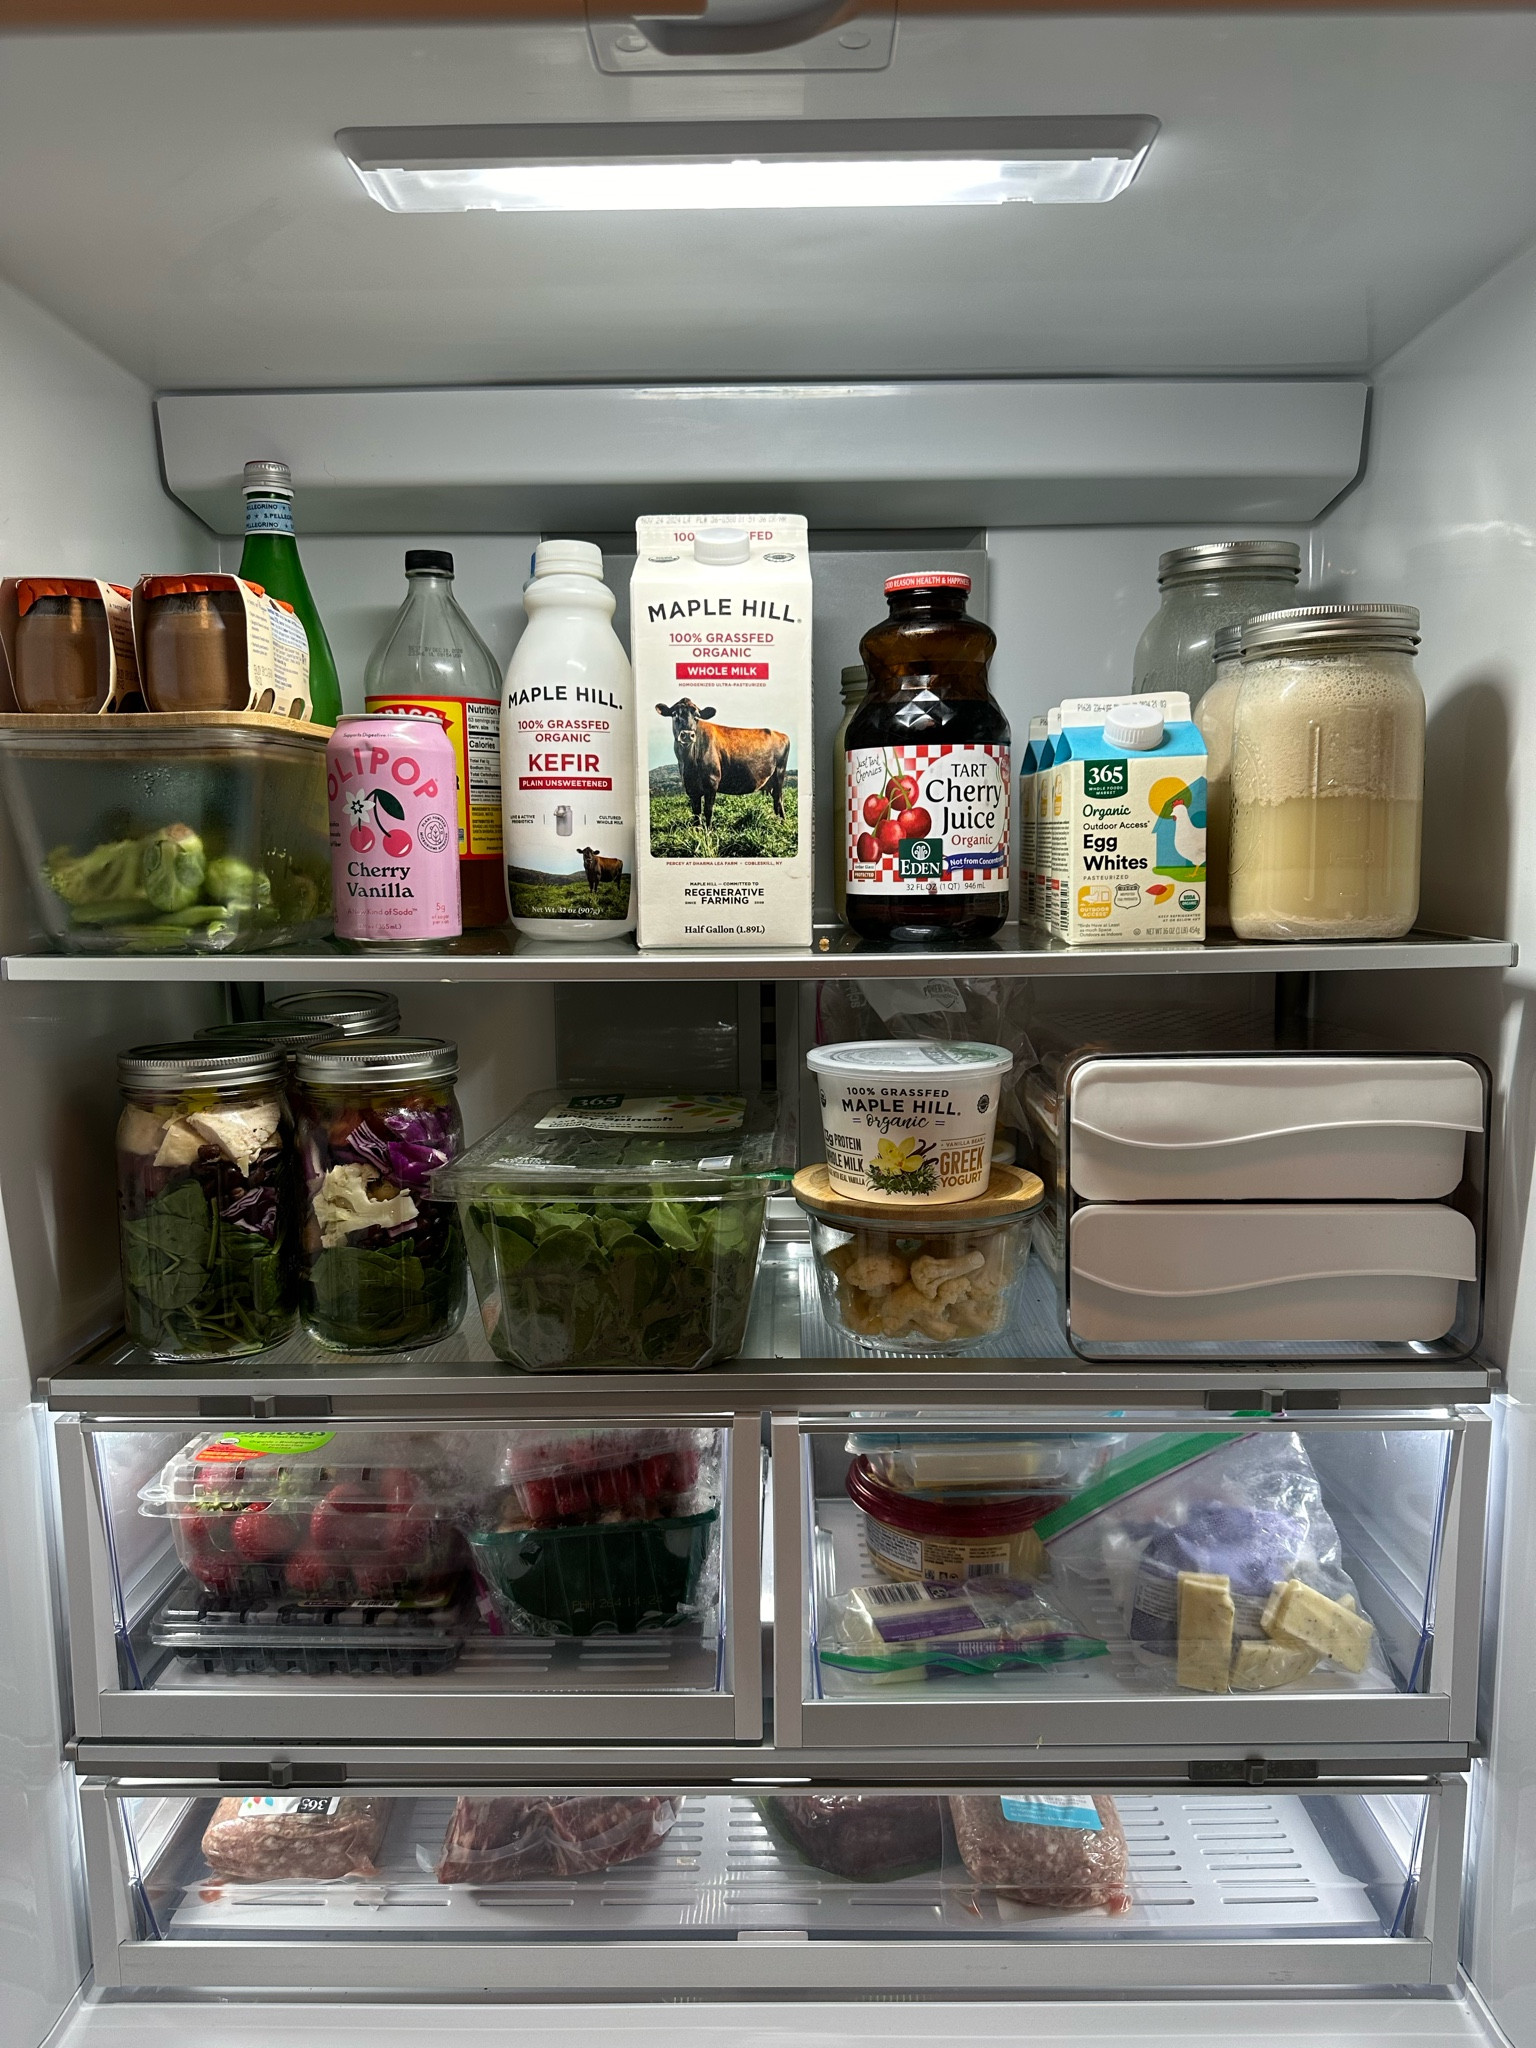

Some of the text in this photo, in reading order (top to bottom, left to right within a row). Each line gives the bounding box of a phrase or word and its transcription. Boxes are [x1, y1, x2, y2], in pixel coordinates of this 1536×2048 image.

[673, 532, 696, 542] 100
[916, 576, 941, 586] HEALTH
[648, 598, 732, 623] MAPLE
[669, 633, 775, 643] 100% GRASSFED
[692, 647, 752, 658] ORGANIC
[687, 666, 757, 676] WHOLE MILK
[508, 685, 568, 709] MAPLE
[467, 704, 498, 716] Nutrition
[518, 719, 610, 731] 100% GRASSFED
[468, 740, 496, 750] Calories
[535, 733, 592, 743] ORGANIC
[528, 753, 600, 773] KEFIR
[856, 753, 881, 770] Just Tart
[327, 746, 439, 802] OLIPOP
[950, 763, 988, 778] TART
[1088, 764, 1124, 785] 365
[545, 779, 608, 788] UNSWEETENED
[925, 777, 1002, 808] Cherry
[1082, 803, 1132, 820] Organic
[941, 805, 996, 836] Juice
[1082, 821, 1118, 831] Outdoor
[951, 833, 993, 848] Organic
[1083, 833, 1118, 852] Egg
[900, 859, 941, 876] EDEN
[949, 857, 963, 867] Not
[963, 856, 979, 866] from
[1082, 854, 1148, 871] Whites
[347, 861, 411, 881] Cherry
[346, 882, 415, 898] Vanilla
[684, 888, 765, 897] REGENERATIVE
[906, 883, 915, 891] 32
[916, 883, 924, 891] FL
[701, 896, 749, 905] FARMING
[384, 907, 392, 915] of
[684, 925, 766, 935] Half Gallon (1.89L)
[846, 1087, 949, 1098] 100% GRASSFED
[574, 1096, 618, 1108] 365
[841, 1098, 905, 1113] MAPLE
[865, 1113, 930, 1135] Organic
[834, 1133, 862, 1151] PROTEIN
[843, 1155, 865, 1173] MILK
[940, 1146, 985, 1176] GREEK
[940, 1171, 983, 1188] YOGURT
[301, 1798, 329, 1811] 365
